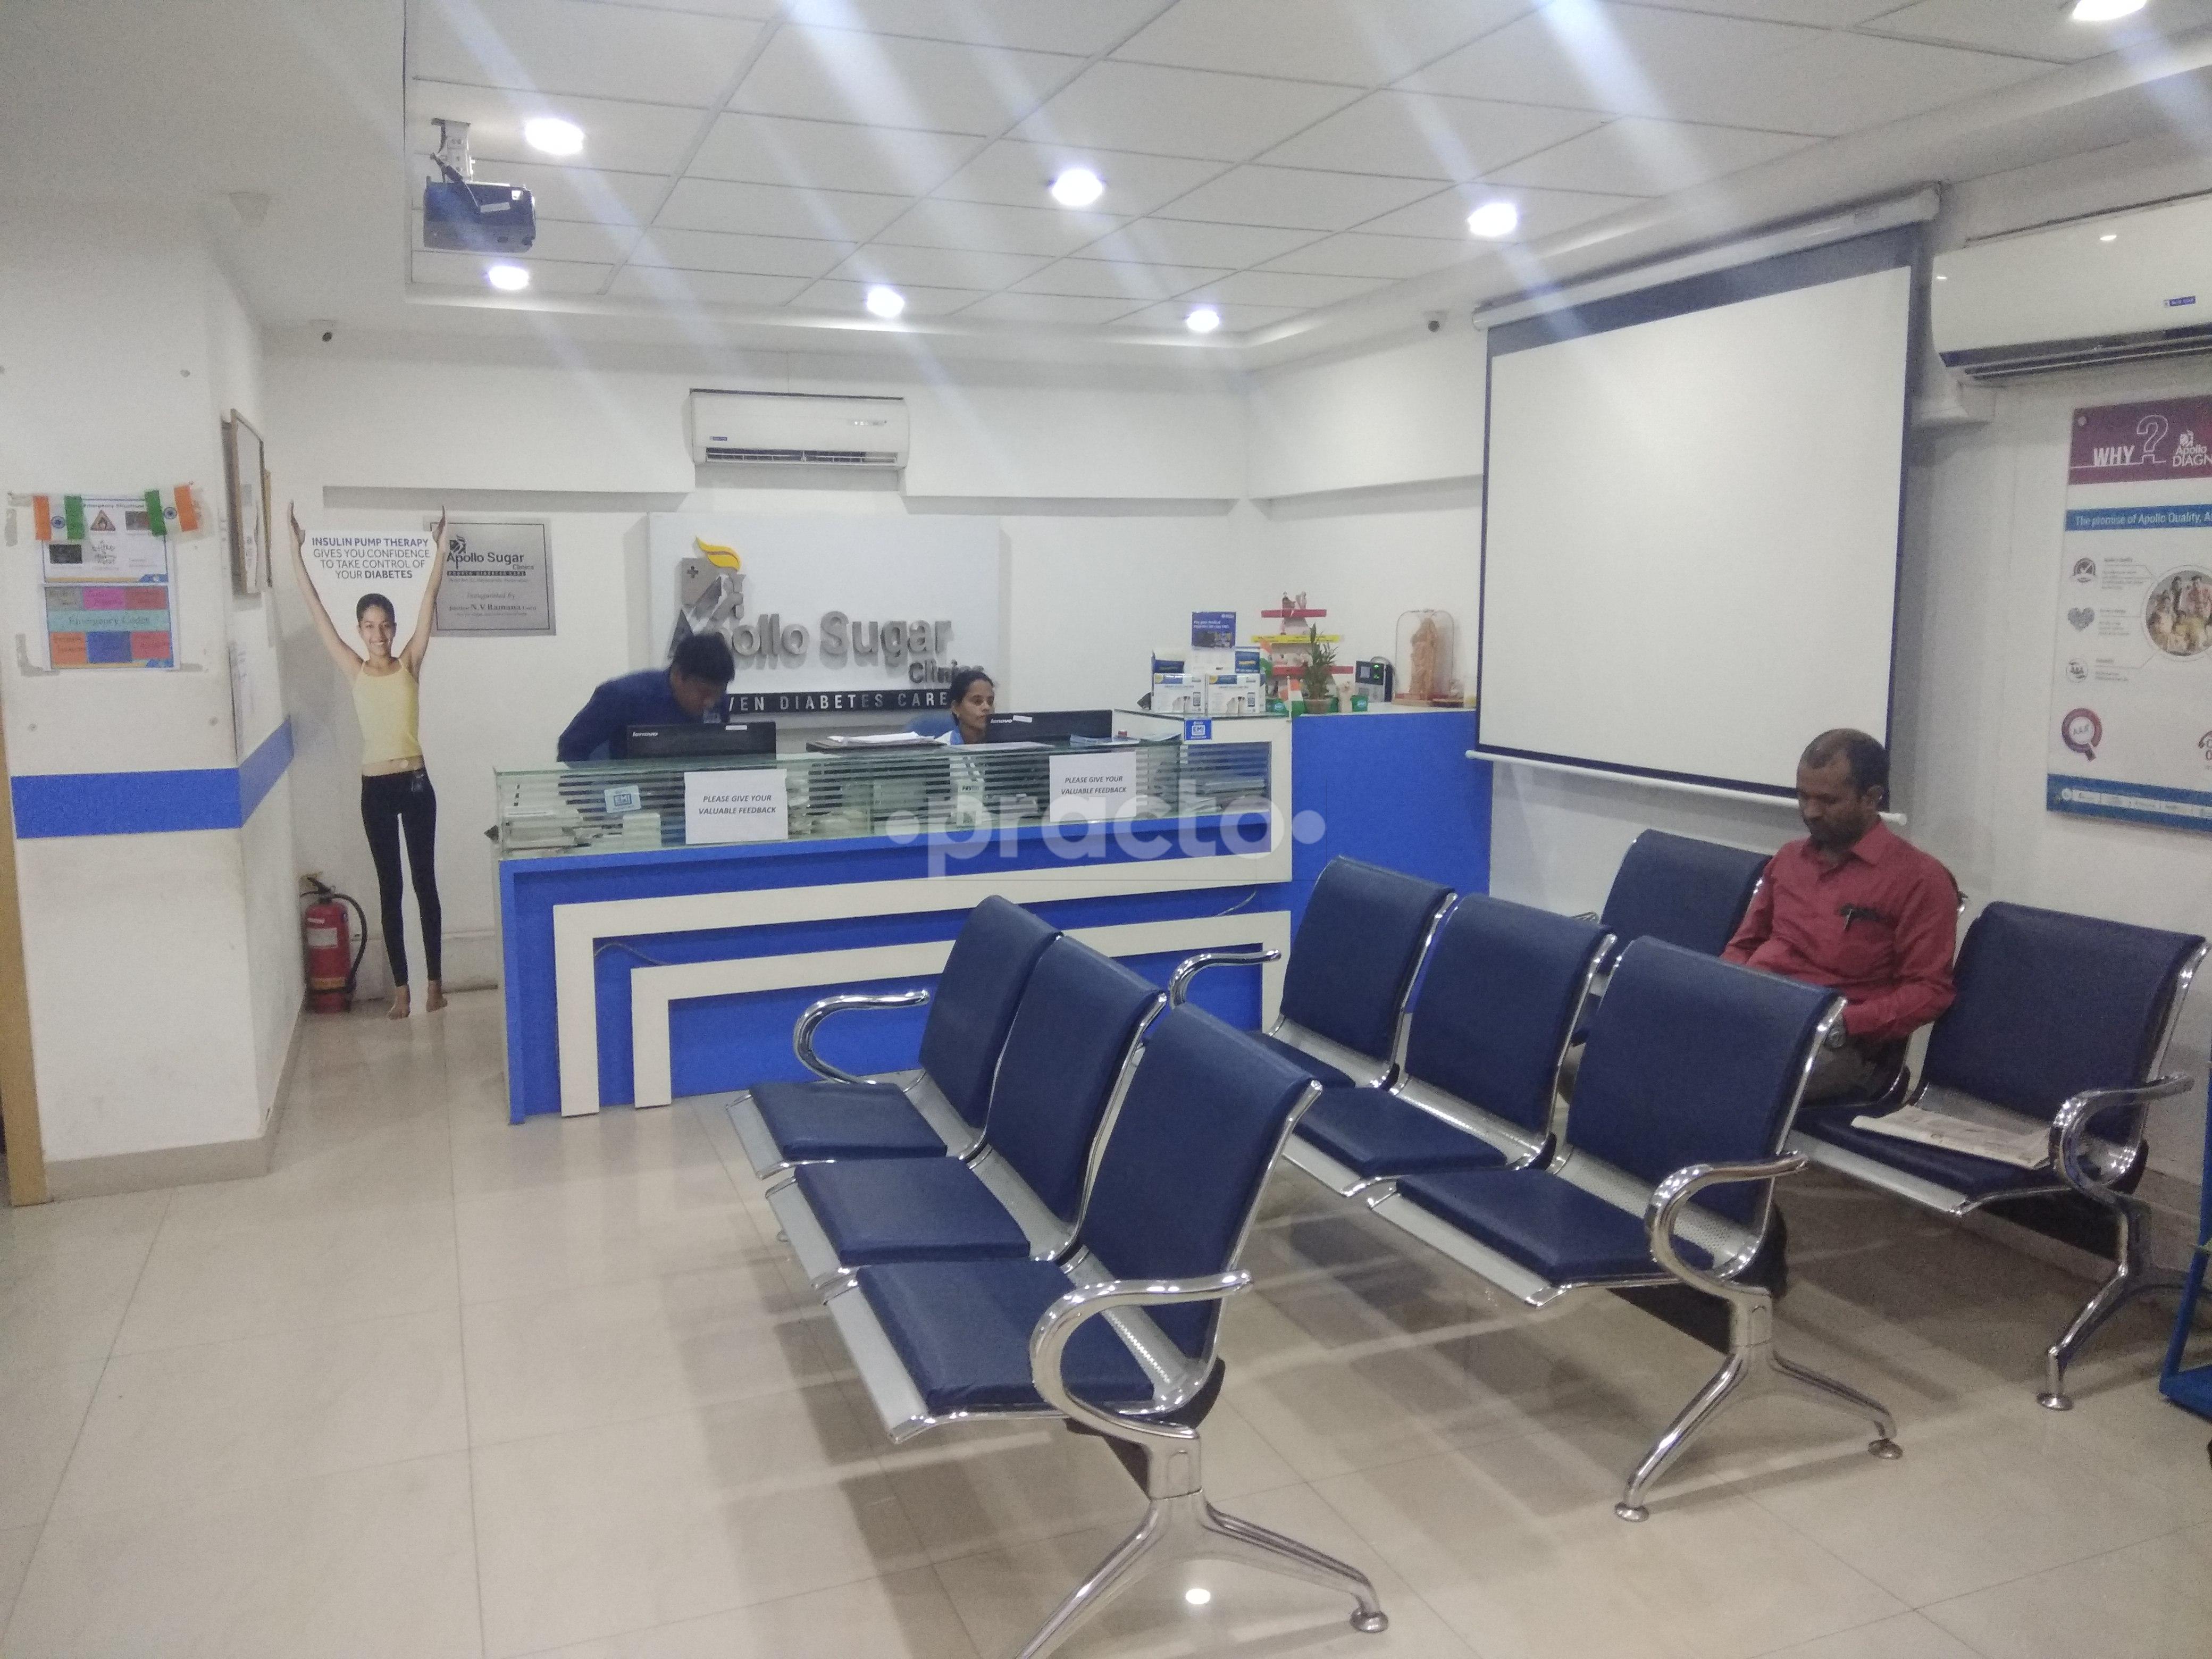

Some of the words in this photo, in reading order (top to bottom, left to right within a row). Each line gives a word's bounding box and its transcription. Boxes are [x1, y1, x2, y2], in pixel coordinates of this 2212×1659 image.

[2093, 445, 2135, 466] WHY
[2176, 444, 2207, 456] Apollo
[2076, 516, 2090, 525] The
[2127, 514, 2136, 524] of
[2138, 513, 2166, 525] Apollo
[2168, 512, 2202, 524] Quality,
[312, 537, 352, 547] INSULIN
[355, 538, 381, 547] PUMP
[383, 538, 429, 547] THERAPY
[314, 549, 342, 558] GIVES
[345, 549, 365, 558] YOU
[367, 549, 431, 558] CONFIDENCE
[321, 560, 334, 568] TO
[337, 560, 361, 568] TAKE
[363, 560, 411, 568] CONTROL
[413, 559, 425, 568] OF
[447, 551, 484, 569] Apollo
[488, 552, 524, 565] Sugar
[336, 571, 363, 579] YOUR
[365, 570, 413, 579] DIABETES
[820, 611, 952, 667] Sugar
[780, 693, 883, 710] DIABETES
[898, 692, 948, 708] CARE
